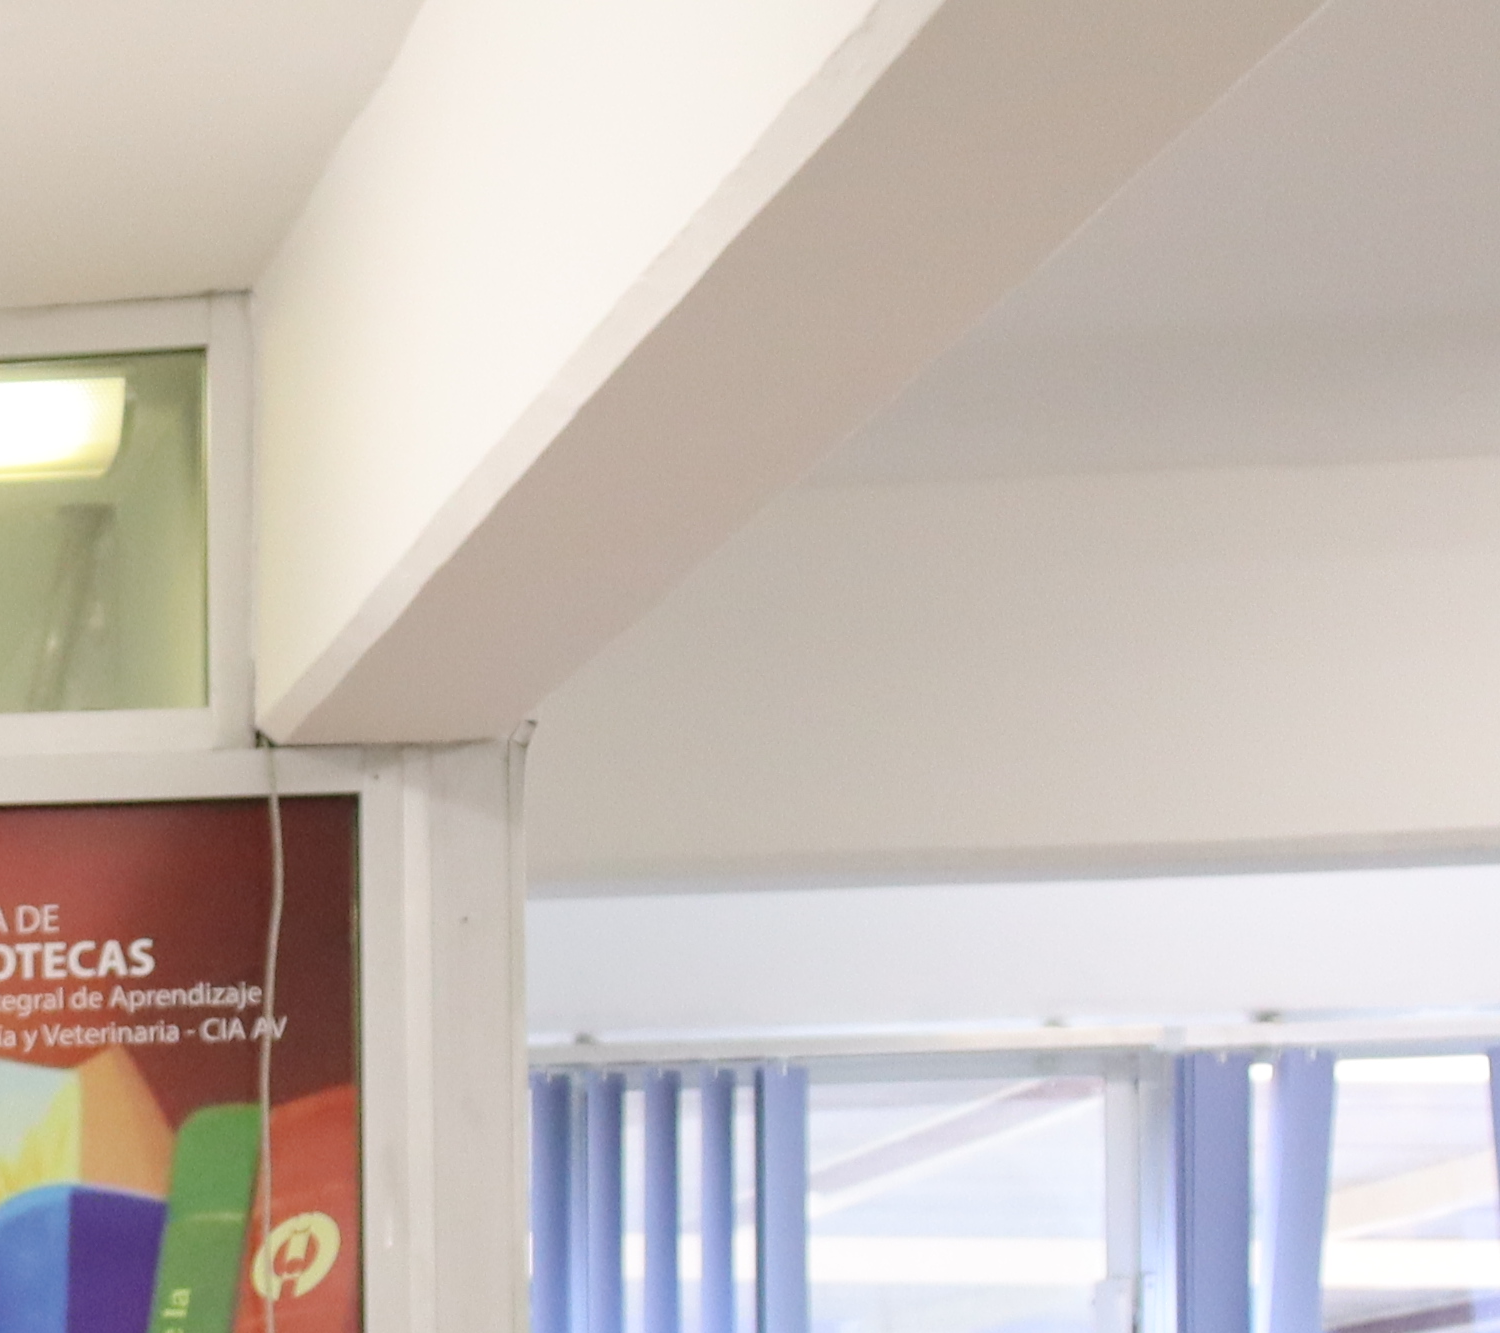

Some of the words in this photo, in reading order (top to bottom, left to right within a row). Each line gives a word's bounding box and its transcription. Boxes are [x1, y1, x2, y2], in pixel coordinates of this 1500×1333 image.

[15, 903, 61, 934] DE
[69, 984, 104, 1010] de
[108, 980, 263, 1014] Aprendizaje
[22, 1028, 39, 1052] y
[41, 1019, 181, 1048] Veterinaria
[199, 1016, 247, 1043] CIA
[251, 1014, 288, 1041] AV
[161, 1287, 191, 1320] la
